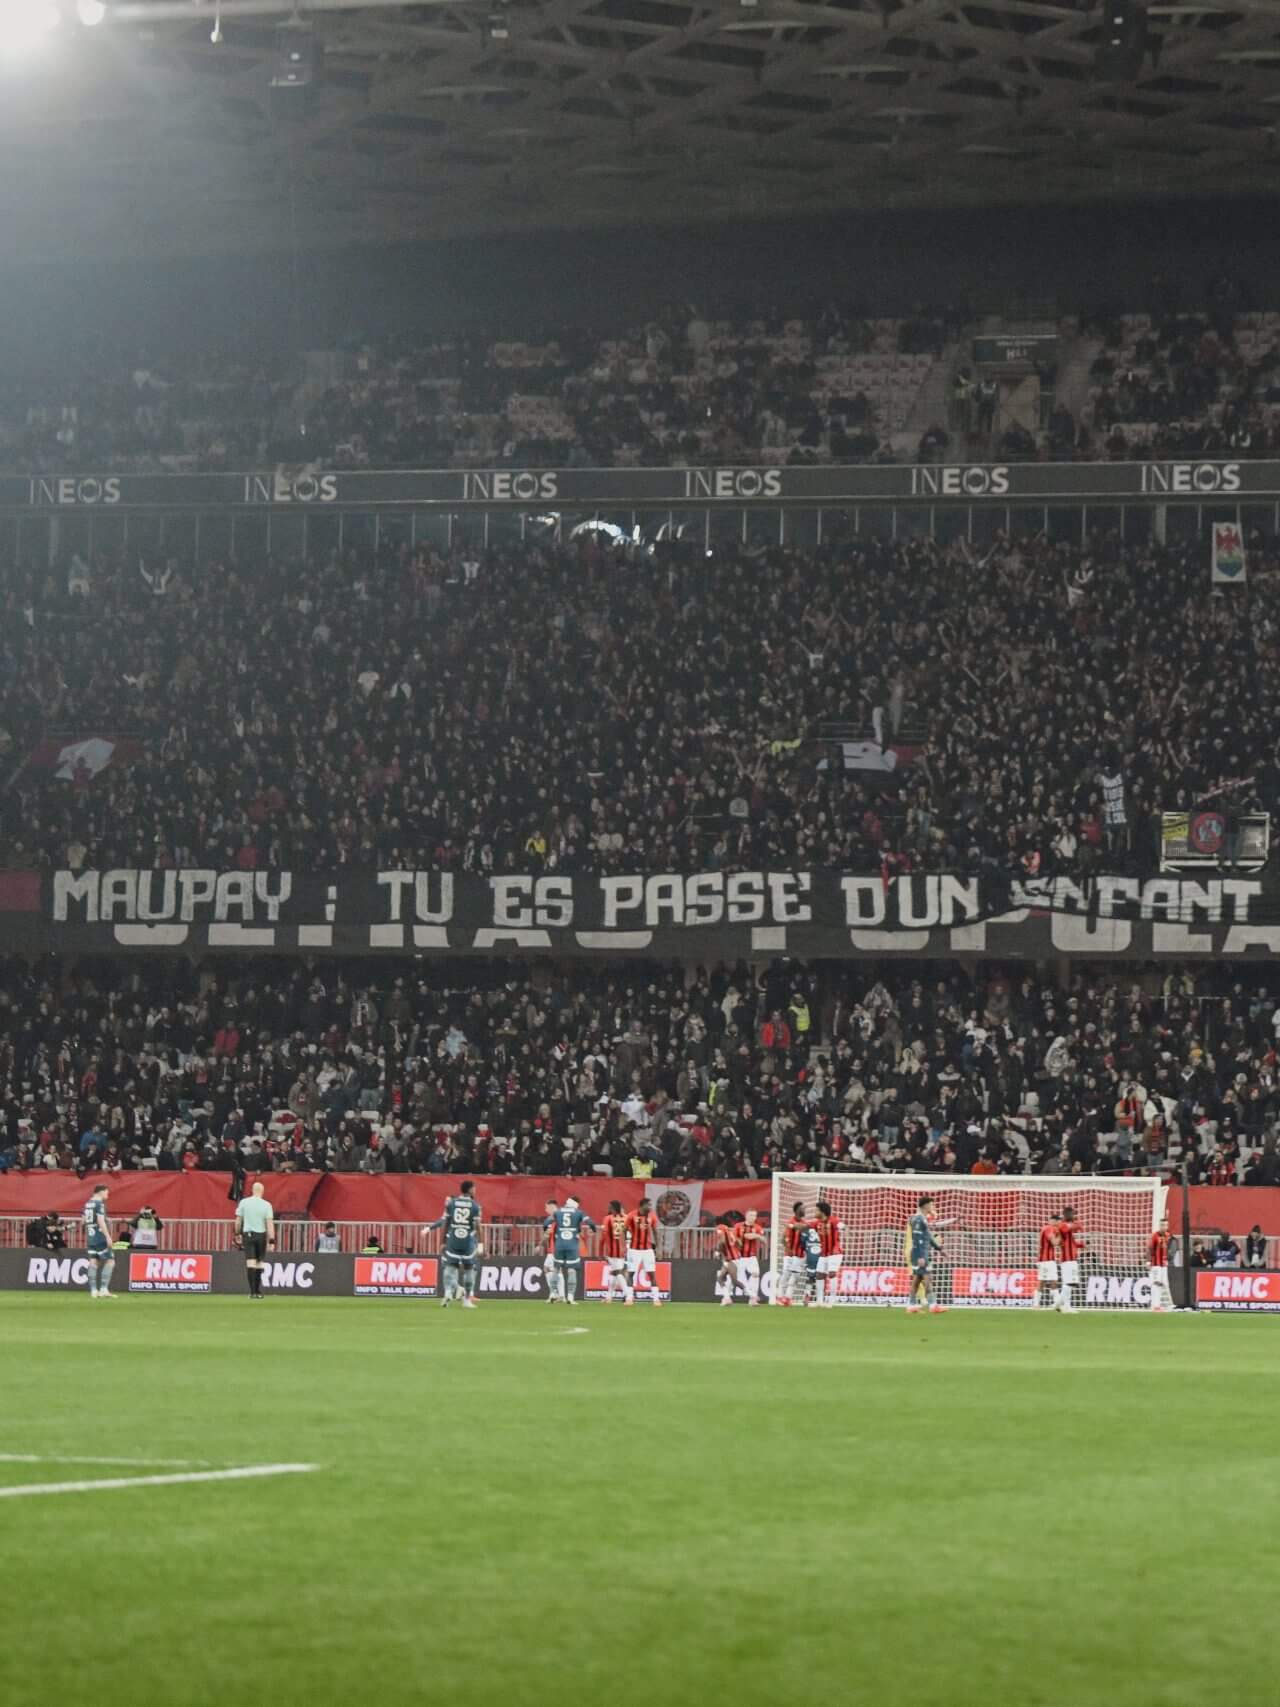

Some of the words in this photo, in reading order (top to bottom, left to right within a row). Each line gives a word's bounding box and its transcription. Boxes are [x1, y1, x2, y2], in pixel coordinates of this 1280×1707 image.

[463, 473, 557, 499] INEOS
[685, 470, 781, 496] INEOS
[911, 467, 1008, 495] INEOS
[1141, 464, 1240, 492] INEOS
[29, 479, 120, 504] INEOS
[53, 870, 292, 922] MAUPAY
[377, 870, 454, 924] TU
[489, 875, 574, 927] ES
[454, 1207, 470, 1223] 62
[562, 1213, 572, 1227] 5
[28, 1257, 89, 1285] RMC
[145, 1257, 197, 1280] RMC
[370, 1261, 423, 1284] RMC
[480, 1265, 543, 1292] RMC
[840, 1269, 896, 1293] RMC
[969, 1271, 1025, 1295] RMC
[1085, 1276, 1152, 1303] RMC
[1213, 1275, 1270, 1299] RMC
